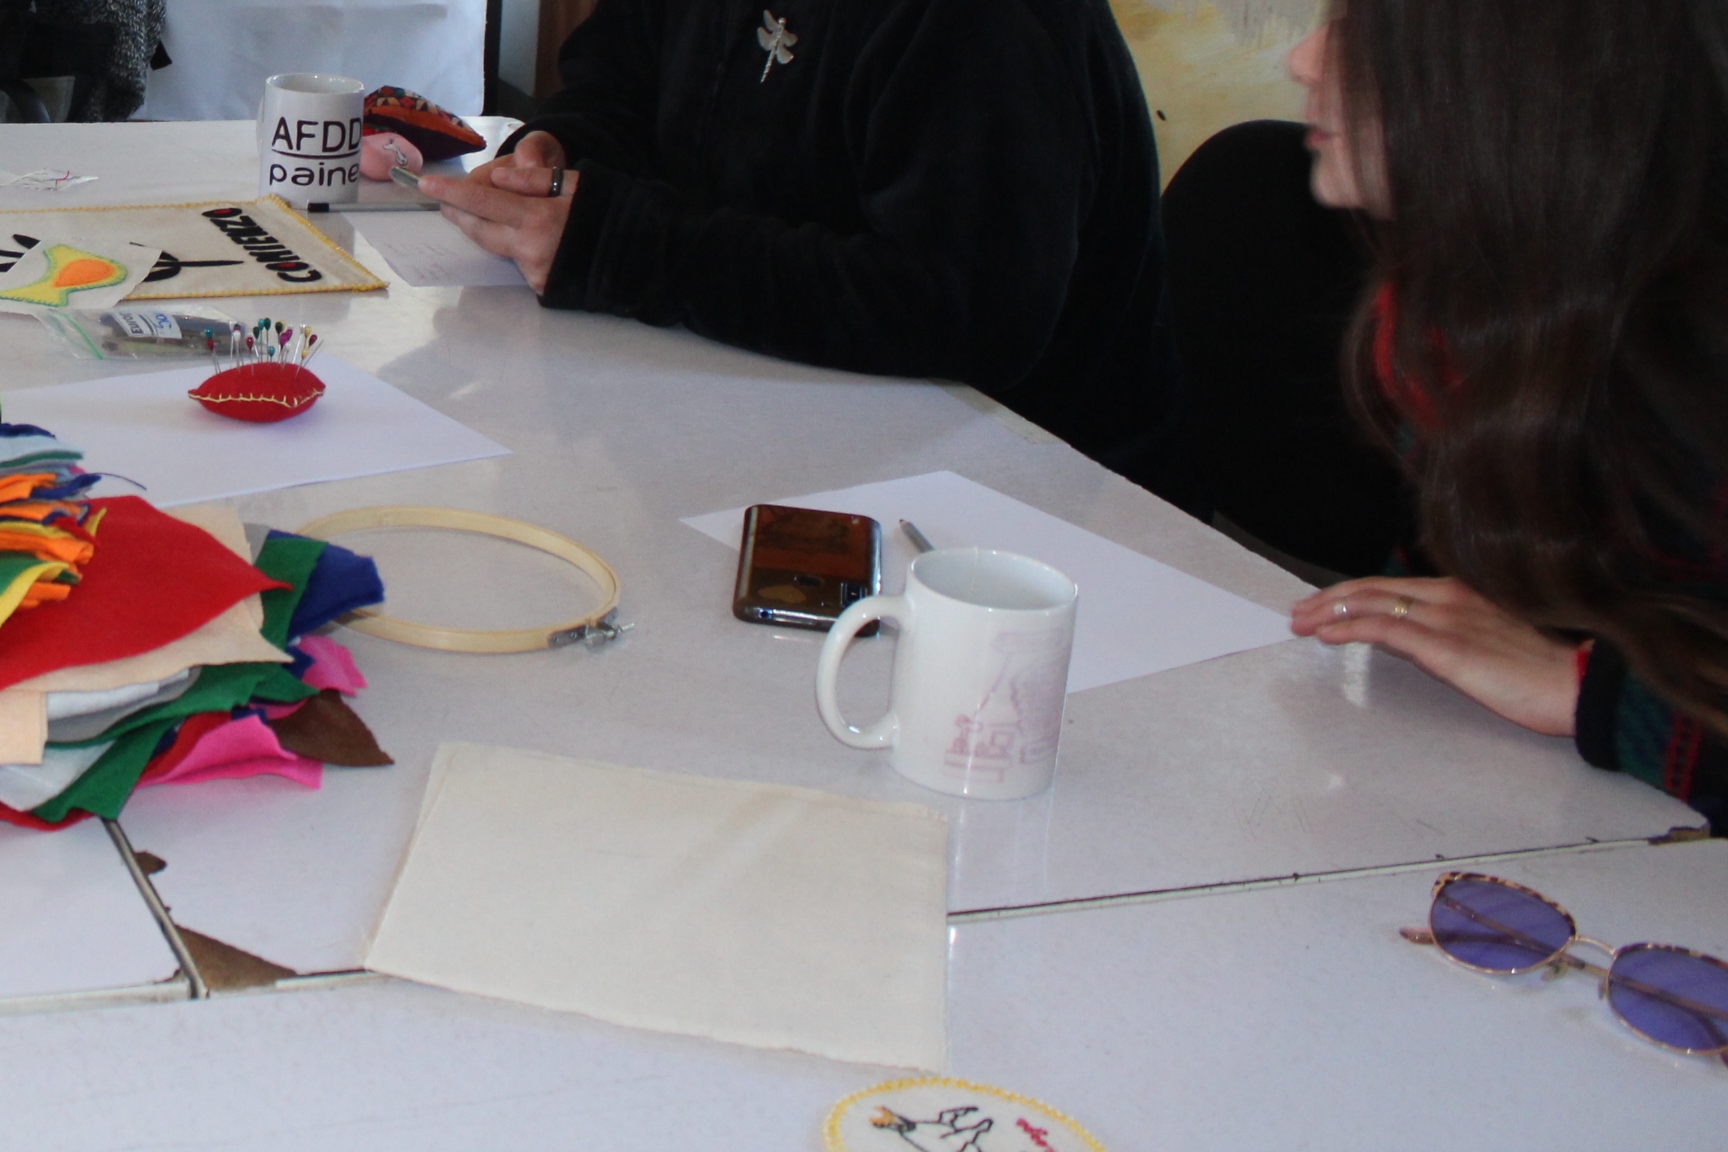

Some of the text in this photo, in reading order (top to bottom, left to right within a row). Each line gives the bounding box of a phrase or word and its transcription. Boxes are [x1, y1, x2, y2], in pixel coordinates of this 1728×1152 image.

[271, 116, 363, 152] AFDD
[269, 162, 360, 187] paine
[201, 207, 322, 283] COMIENZO
